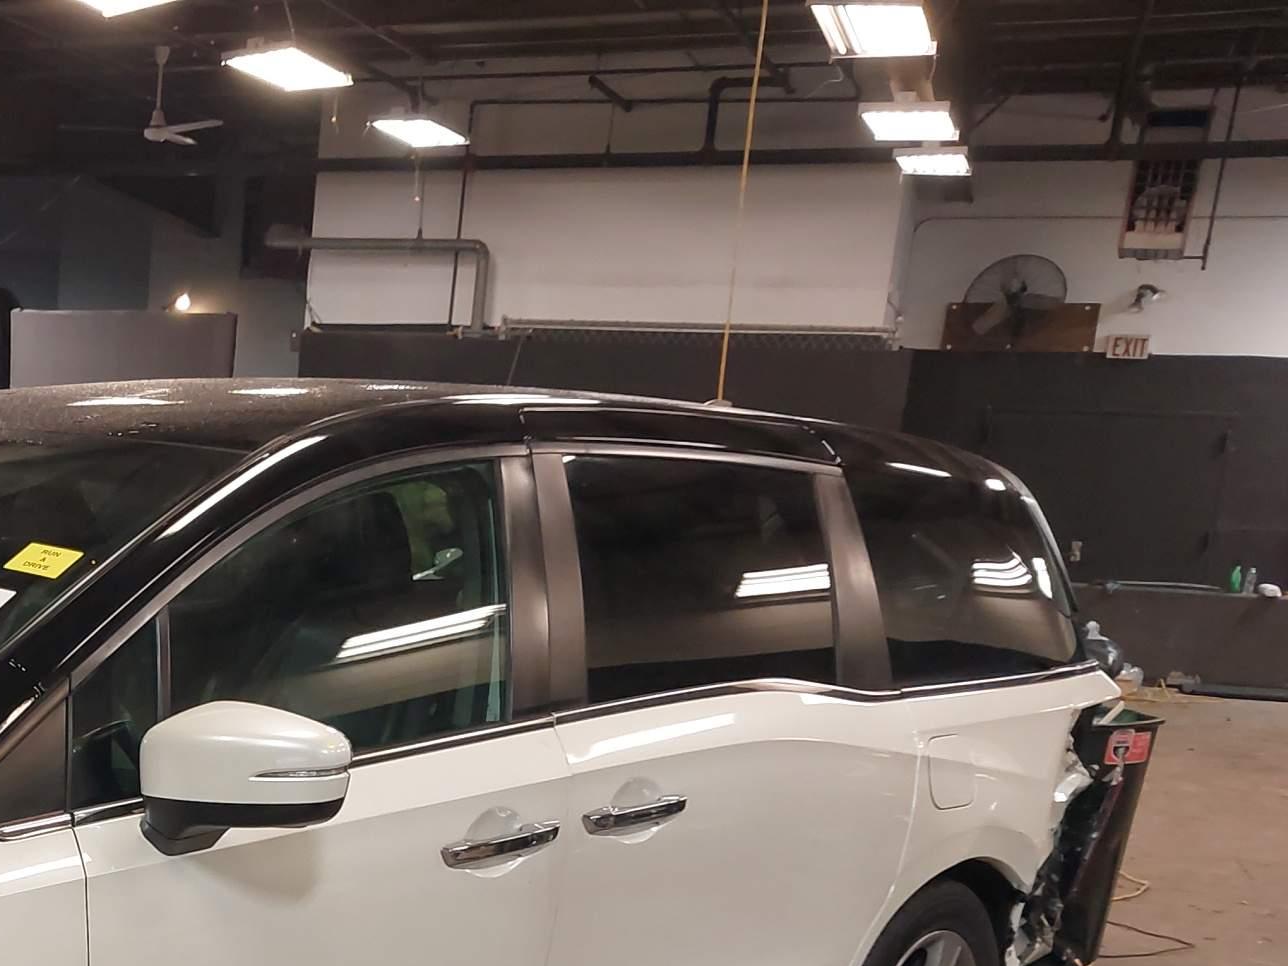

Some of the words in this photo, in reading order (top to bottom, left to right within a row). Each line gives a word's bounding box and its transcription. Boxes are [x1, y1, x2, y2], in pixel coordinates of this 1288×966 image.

[1112, 337, 1149, 357] EXIT
[40, 549, 62, 557] RUN
[23, 561, 50, 571] DRIVE
